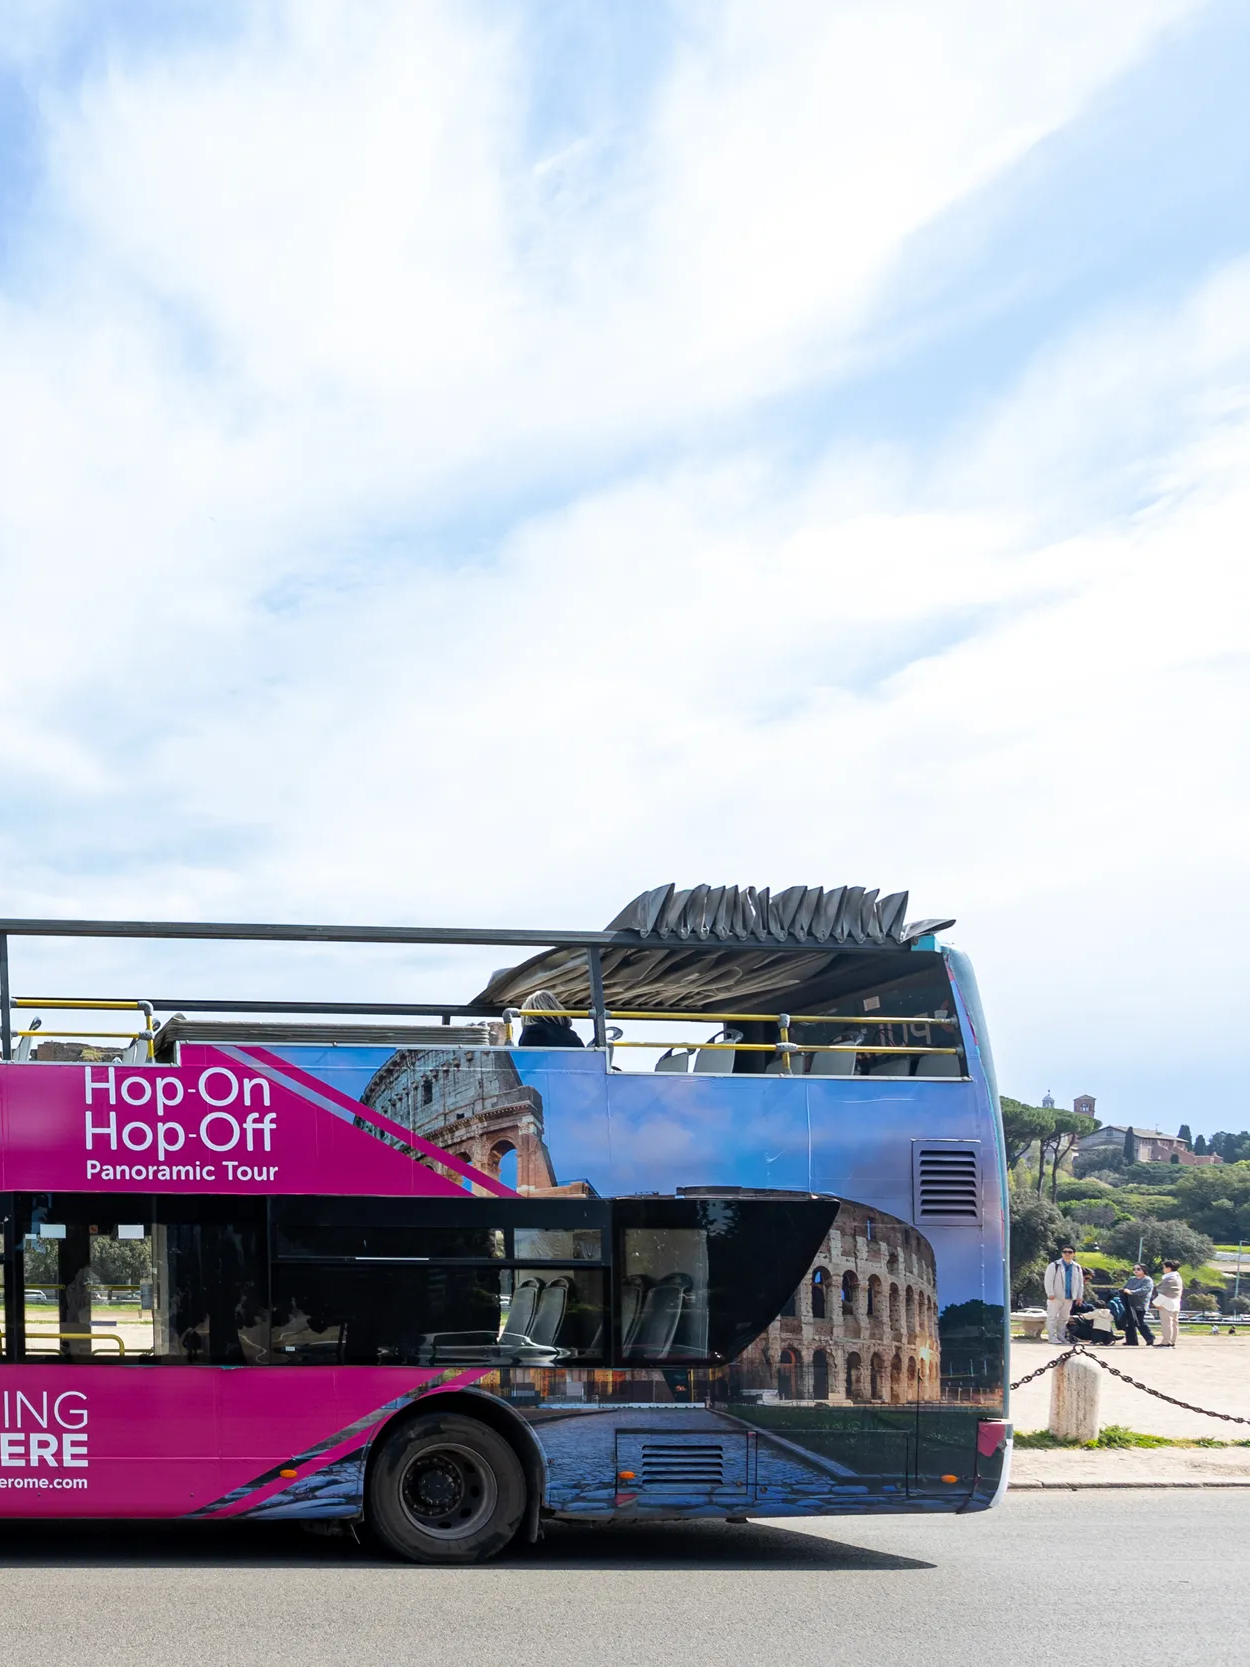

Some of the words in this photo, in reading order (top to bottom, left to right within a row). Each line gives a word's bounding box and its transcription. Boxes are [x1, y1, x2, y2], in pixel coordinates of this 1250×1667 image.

[84, 1066, 270, 1116] Hop-On
[85, 1110, 277, 1162] Hop-Off
[86, 1160, 216, 1181] Panoramic
[222, 1161, 279, 1181] Tour
